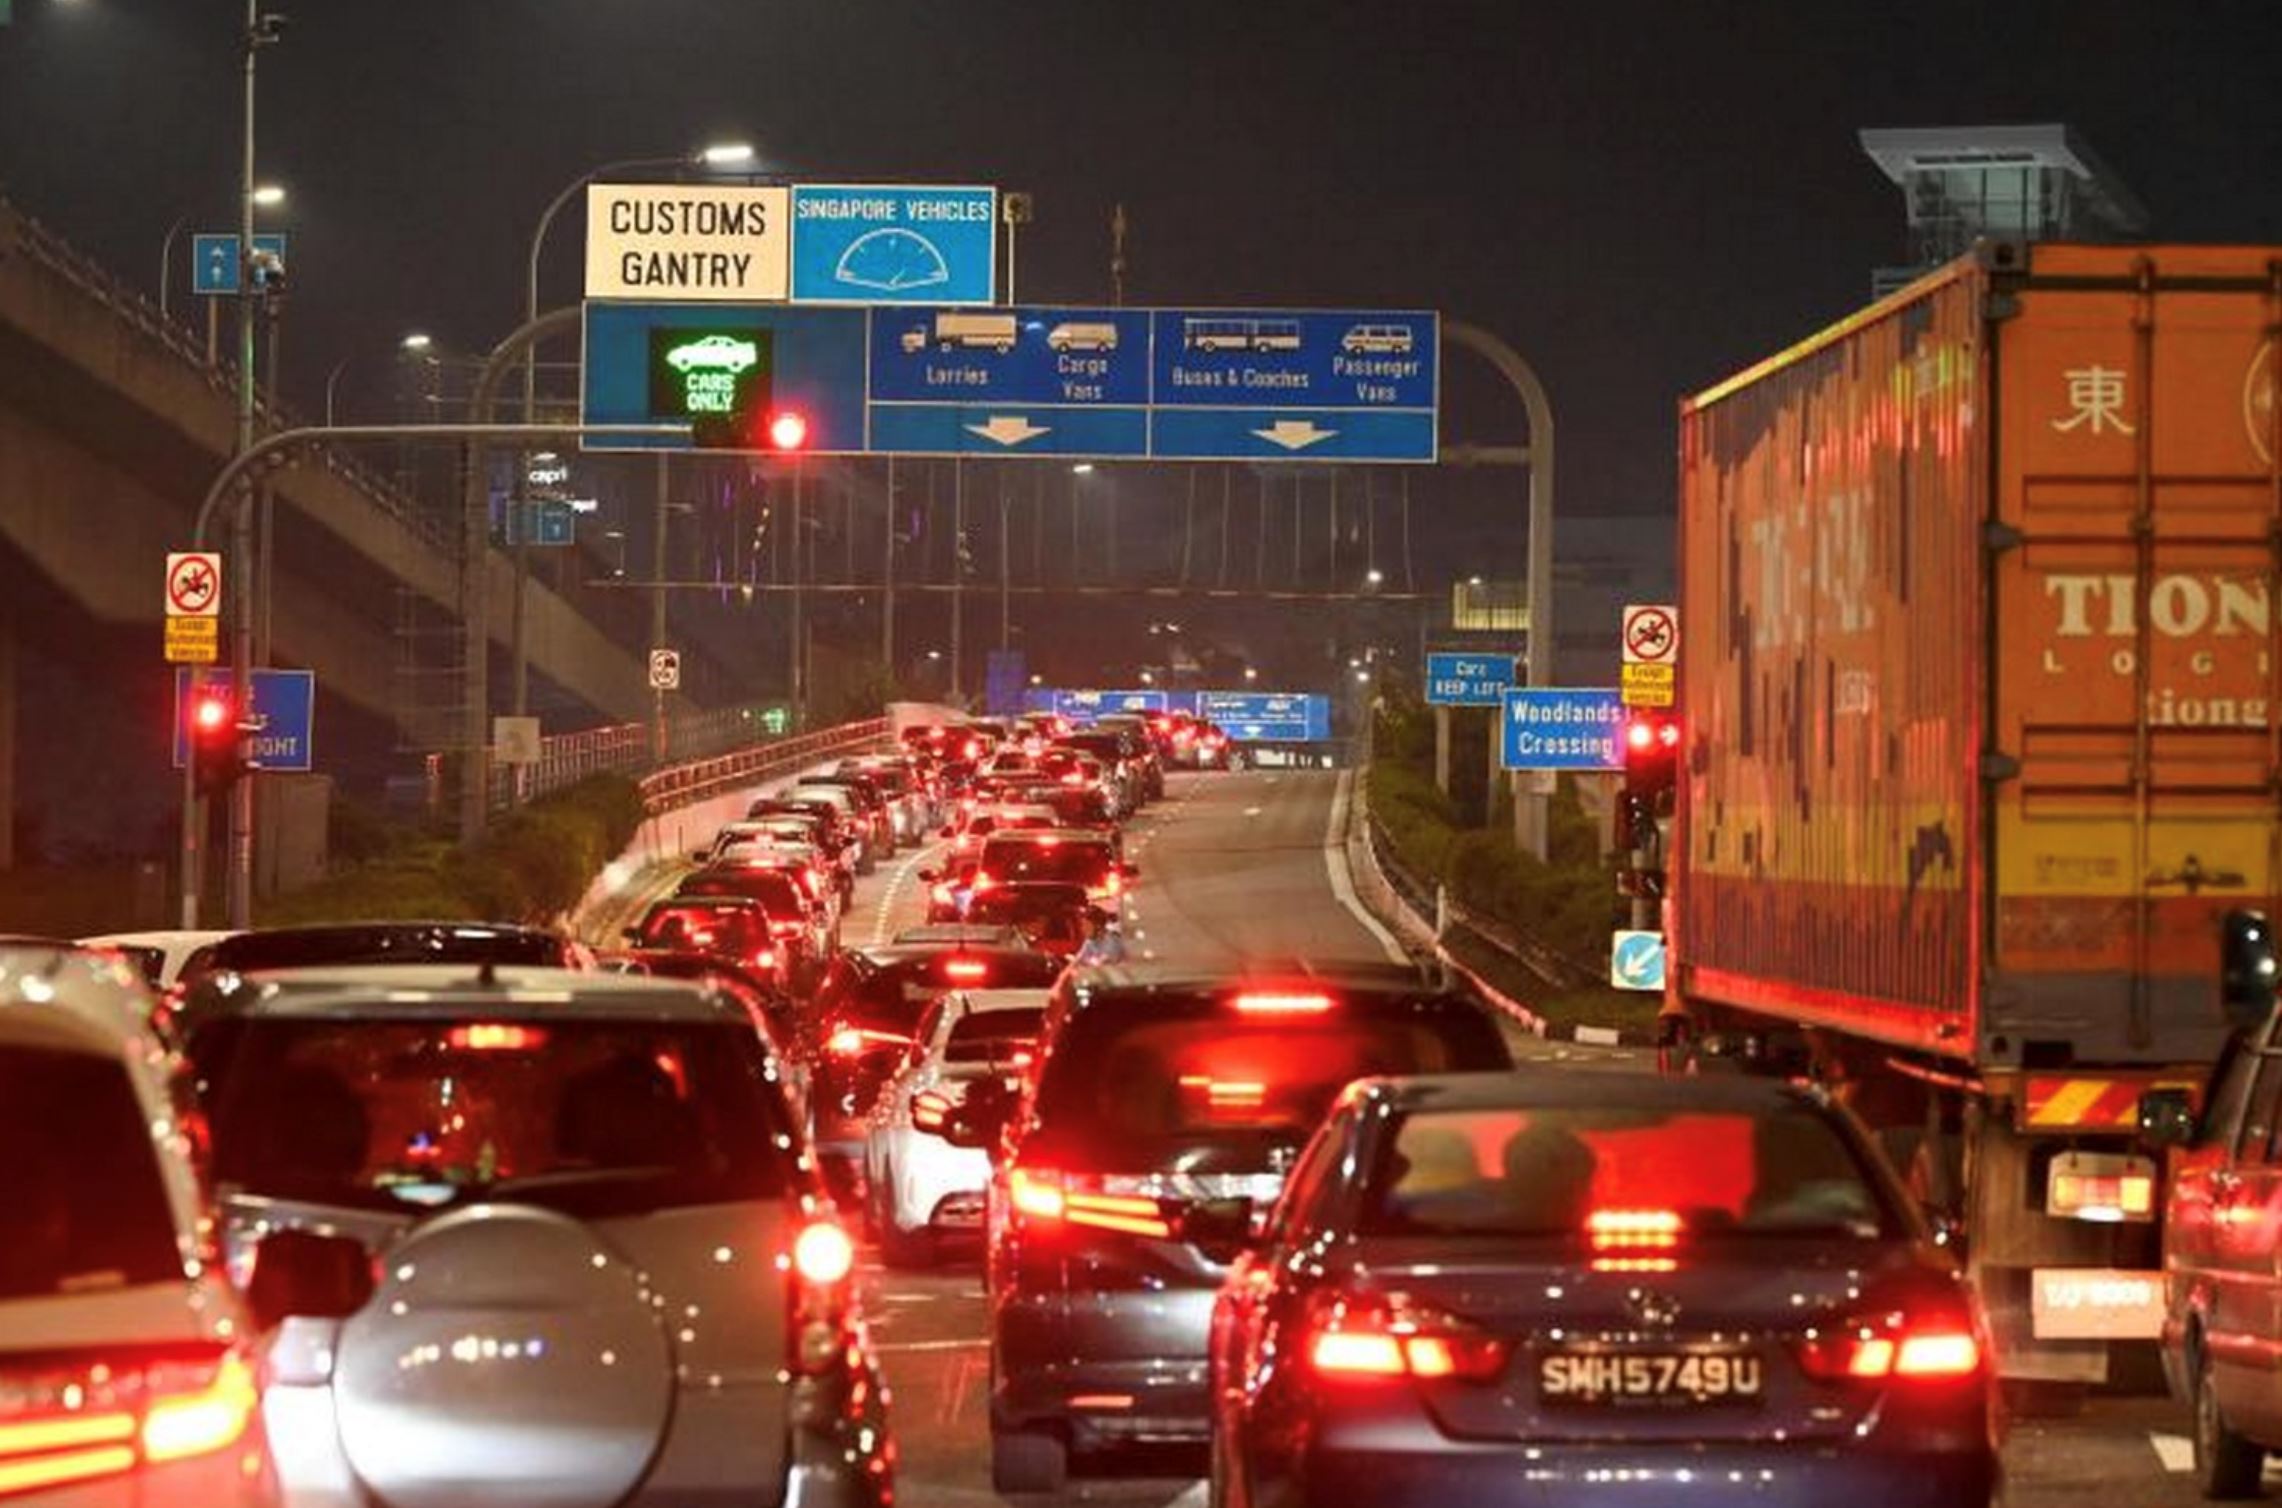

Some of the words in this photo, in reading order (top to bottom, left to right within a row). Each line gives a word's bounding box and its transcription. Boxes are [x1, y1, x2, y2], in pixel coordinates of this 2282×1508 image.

[611, 200, 767, 236] CUSTOMS
[797, 199, 897, 220] SINGAPORE
[907, 200, 991, 221] VEHICLES
[622, 251, 752, 288] GANTRY
[926, 364, 989, 386] Lorries
[1057, 354, 1108, 376] Cargo
[1332, 355, 1420, 378] Passenger
[687, 373, 735, 391] CARS
[1172, 366, 1222, 387] Buses
[1228, 367, 1239, 387] &
[1242, 367, 1310, 388] Coaches
[687, 392, 733, 411] ONLY
[1062, 381, 1104, 401] Vans
[1356, 381, 1398, 402] Vans
[2050, 364, 2136, 434] 東
[2045, 574, 2270, 636] TION
[1512, 700, 1622, 724] Woodlands
[1518, 731, 1615, 761] Crossing
[1541, 1356, 1760, 1394] SMH5749U
